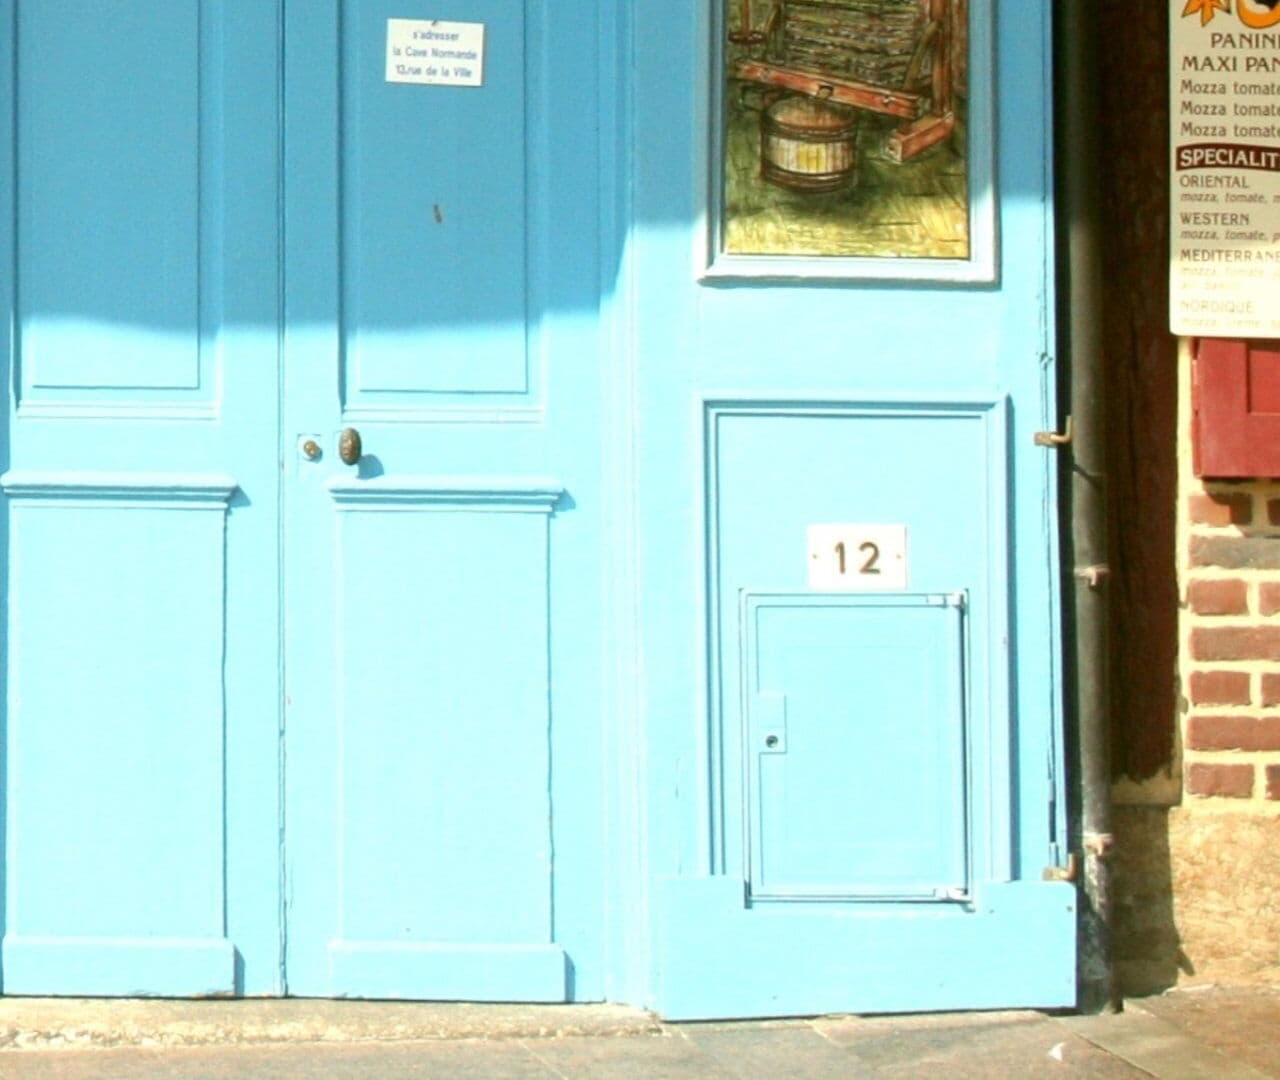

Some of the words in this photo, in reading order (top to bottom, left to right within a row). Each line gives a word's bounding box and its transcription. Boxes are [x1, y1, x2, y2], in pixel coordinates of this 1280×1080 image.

[405, 46, 428, 58] Cave
[430, 47, 478, 60] Normande
[425, 66, 438, 77] de
[441, 66, 450, 77] la
[1182, 55, 1238, 72] MAXI
[1180, 79, 1226, 95] Mozza
[1180, 100, 1227, 116] Mozza
[1180, 121, 1227, 137] Mozza
[1179, 174, 1250, 189] ORIENTAL
[1180, 212, 1250, 226] WESTERN
[834, 541, 881, 575] 12
